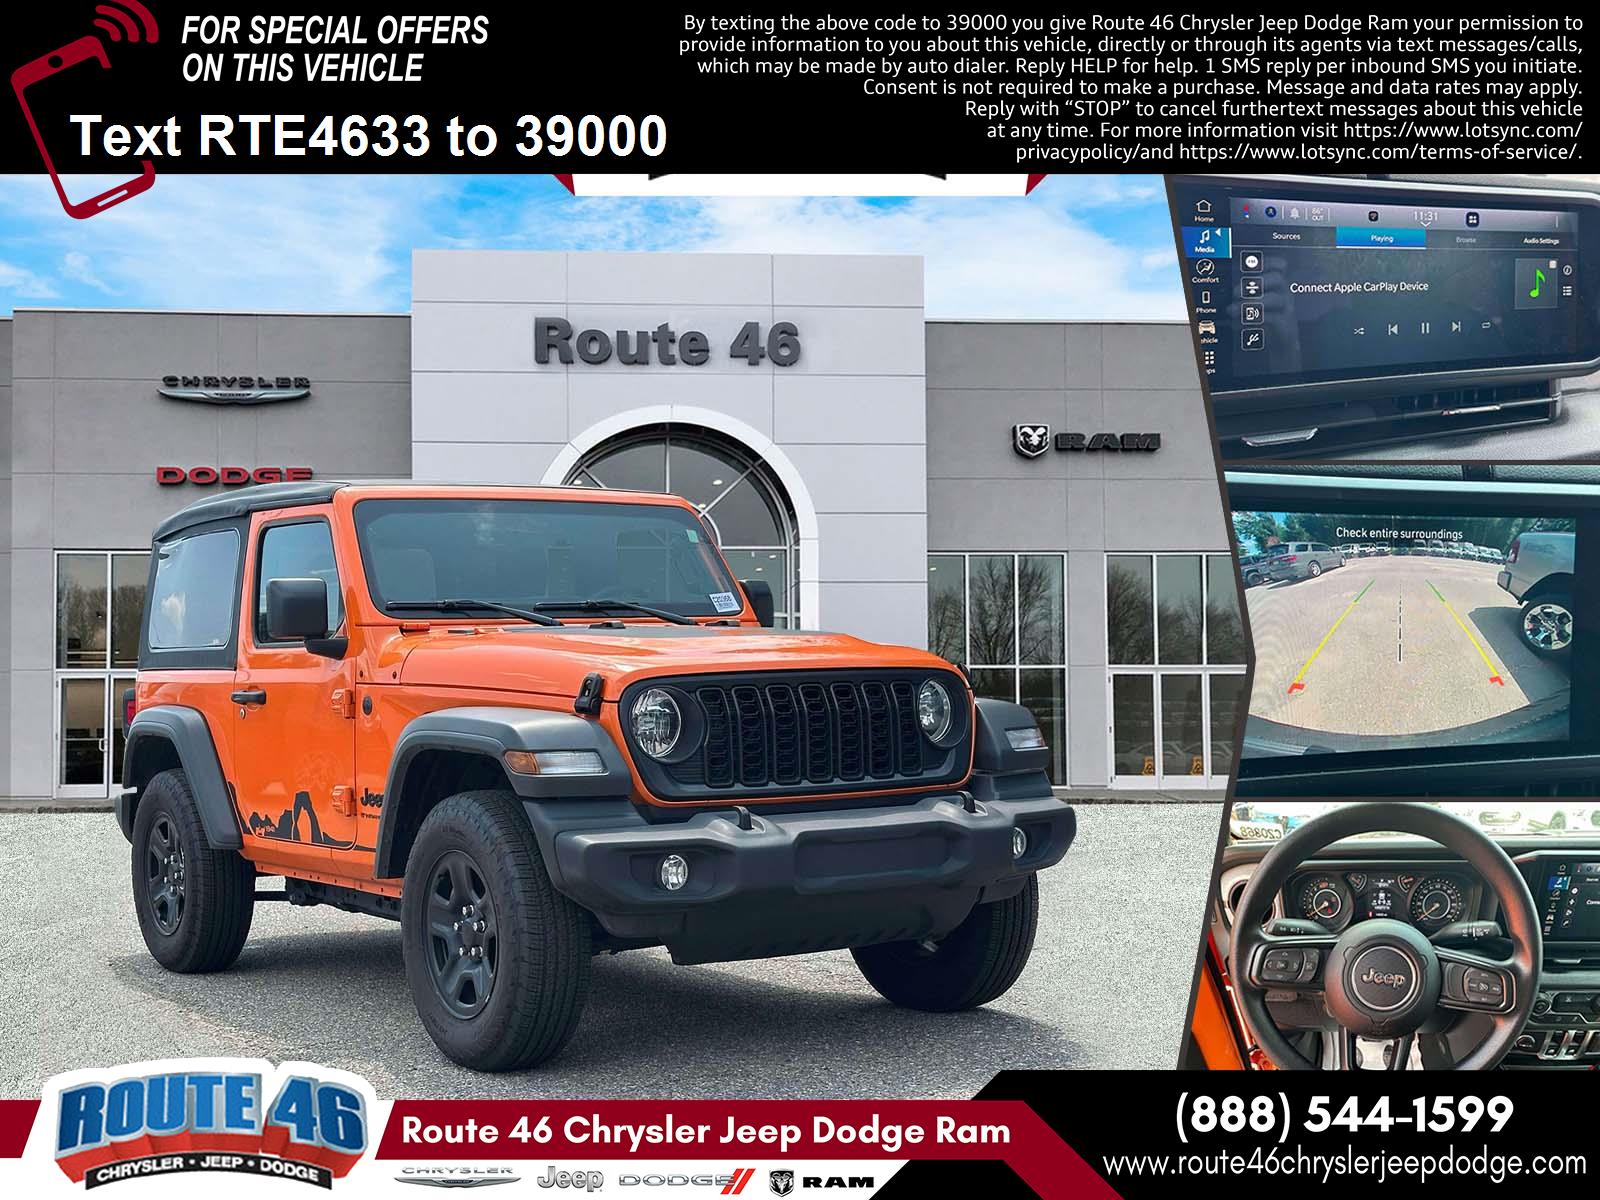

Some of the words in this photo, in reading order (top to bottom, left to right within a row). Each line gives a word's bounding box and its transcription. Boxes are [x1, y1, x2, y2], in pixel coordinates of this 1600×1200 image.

[1414, 211, 1438, 221] 11:31
[1272, 232, 1301, 240] Sources
[1371, 234, 1394, 243] Playing
[1290, 282, 1333, 293] Connect
[1333, 282, 1362, 294] Apple
[1363, 281, 1399, 293] CarPlay
[1400, 281, 1429, 291] Device
[534, 317, 710, 366] Route
[730, 321, 801, 367] 46
[162, 375, 310, 388] CHRYSLER
[1054, 433, 1161, 451] RAM
[156, 466, 313, 485] DODGE
[1336, 527, 1368, 538] Check
[1369, 528, 1399, 539] entire
[1400, 528, 1463, 540] surroundings
[361, 787, 385, 808] Jee
[1361, 968, 1405, 988] Jeep
